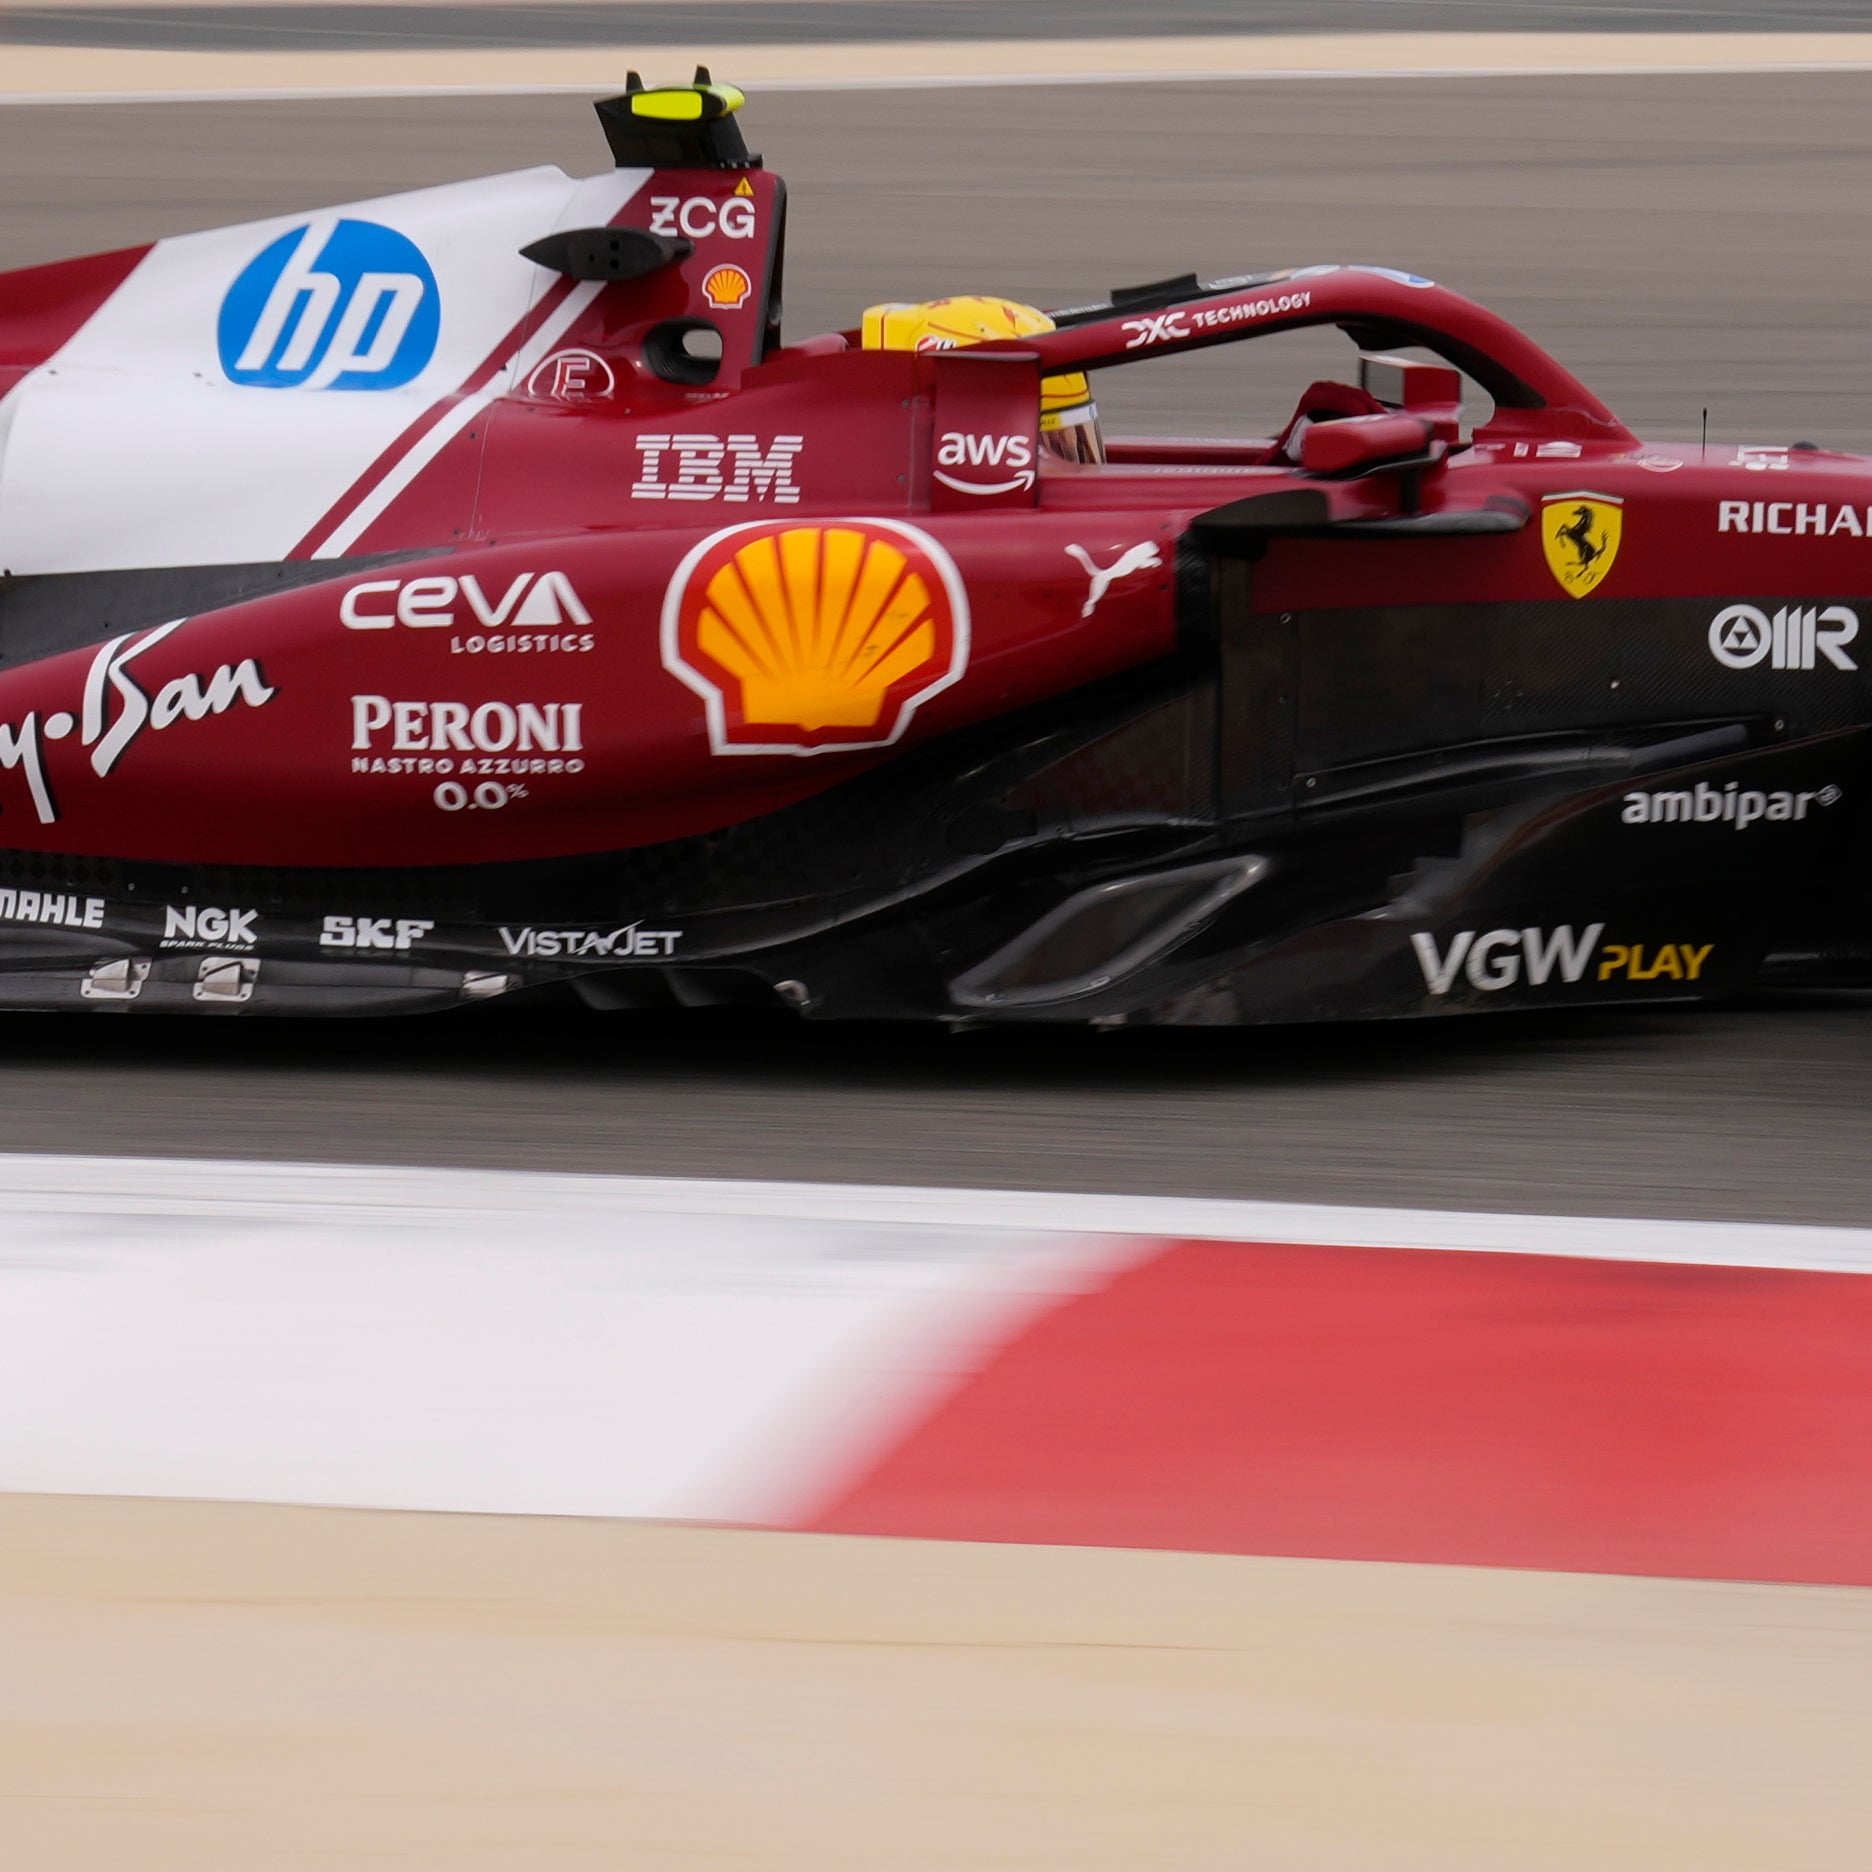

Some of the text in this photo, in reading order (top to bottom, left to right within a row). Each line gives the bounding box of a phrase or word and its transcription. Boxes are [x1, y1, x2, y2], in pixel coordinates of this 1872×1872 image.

[648, 196, 756, 239] ZCG
[233, 217, 425, 390] hp
[1121, 291, 1312, 349] DXC TECHNOLOGY
[631, 433, 804, 504] IBM
[937, 431, 1032, 468] aws
[451, 635, 595, 653] LOGISTICS
[351, 695, 585, 753] PERONI
[351, 757, 586, 776] NASTRO AZZURRO
[1621, 783, 1818, 831] ambipar
[164, 905, 259, 944] NGK
[319, 915, 435, 950] SKF
[1411, 923, 1715, 995] VGW PLAY
